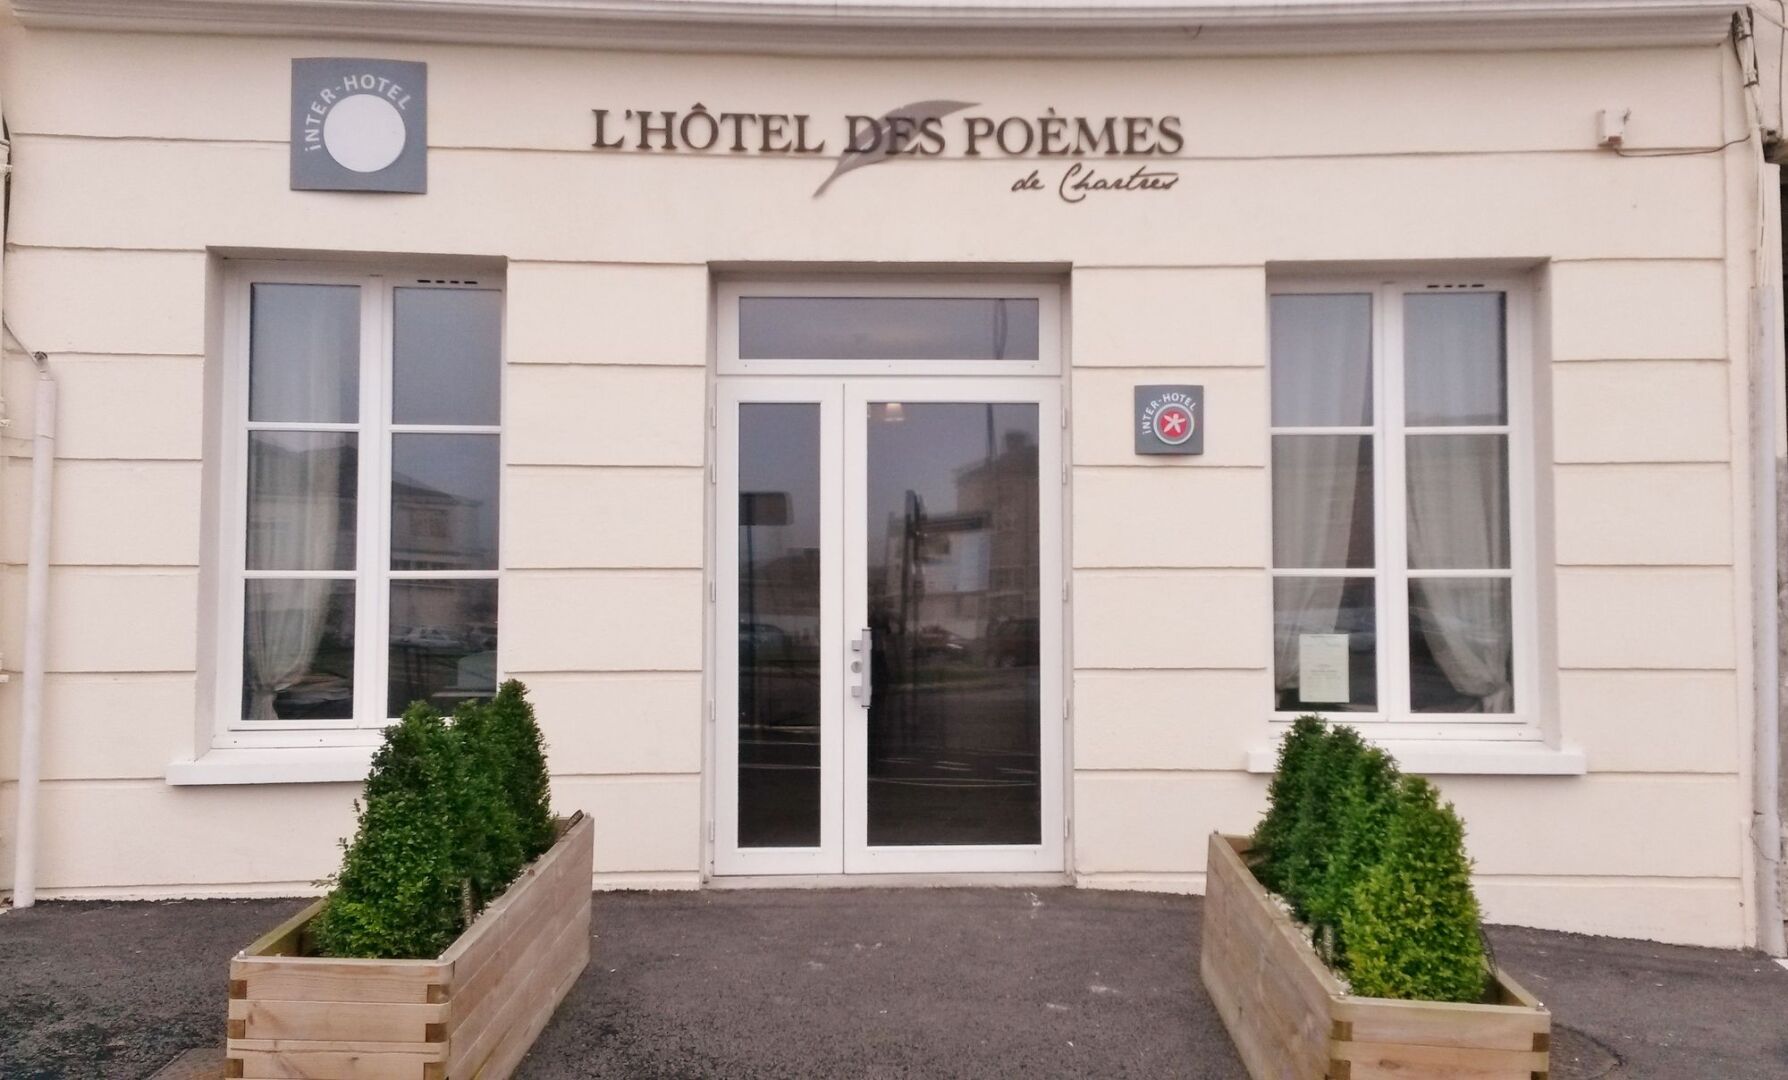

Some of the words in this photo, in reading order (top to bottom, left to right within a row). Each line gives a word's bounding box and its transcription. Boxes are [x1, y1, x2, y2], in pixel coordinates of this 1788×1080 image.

[591, 102, 826, 153] L'HÔTEL
[843, 114, 946, 156] DES
[962, 106, 1185, 156] POÈMES
[1011, 169, 1045, 192] de
[1058, 162, 1179, 203] Chartres
